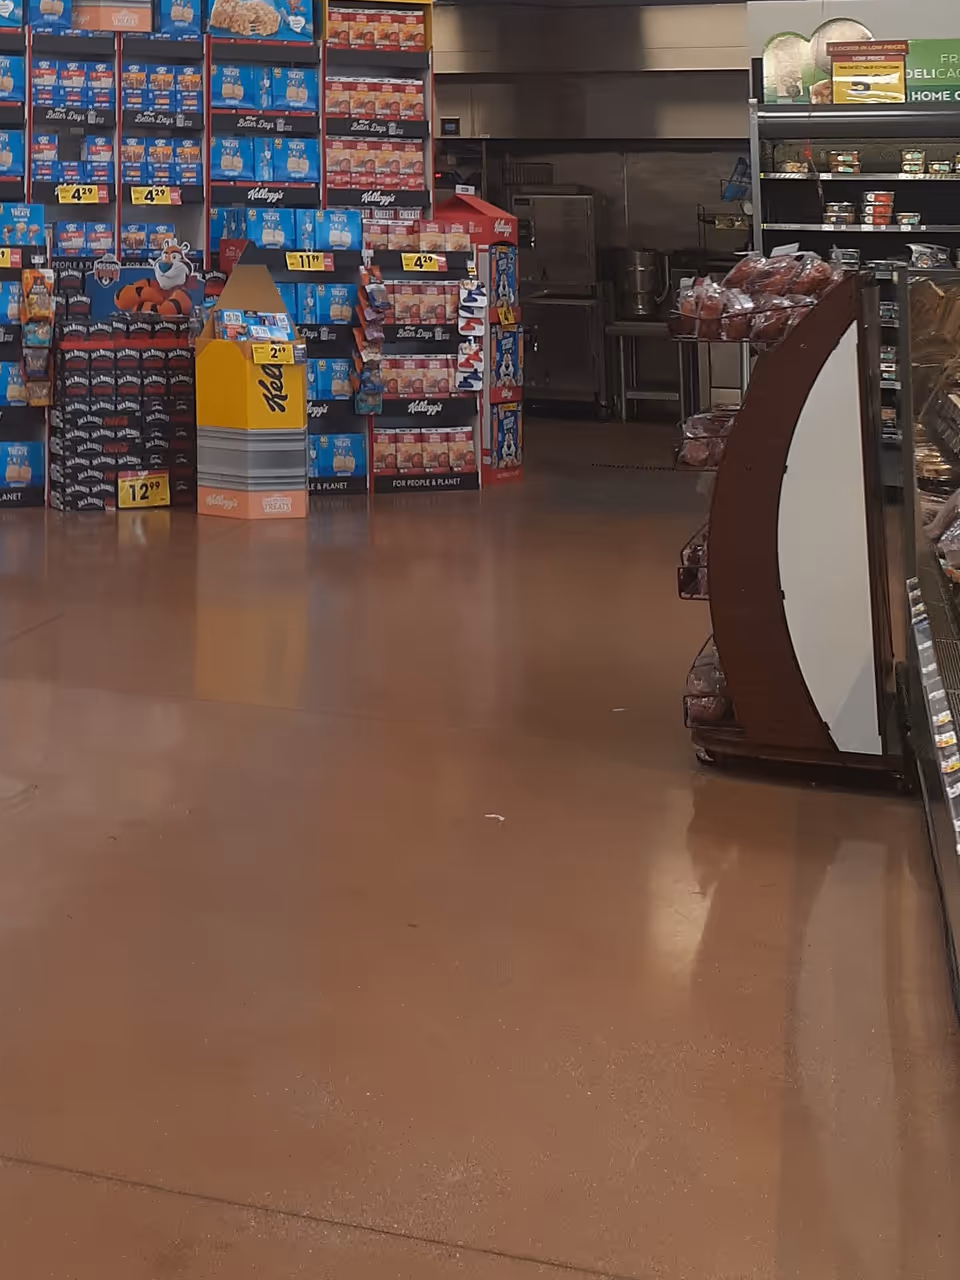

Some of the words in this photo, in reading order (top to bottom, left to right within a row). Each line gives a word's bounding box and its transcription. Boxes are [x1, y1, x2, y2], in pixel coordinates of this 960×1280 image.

[940, 54, 960, 64] FR
[911, 91, 951, 101] HOME
[248, 187, 284, 202] Kellogg's
[361, 190, 396, 205] Kellogg's
[408, 400, 442, 415] Kellogg's
[322, 482, 348, 490] PLANET
[407, 479, 431, 487] PEOPLE
[438, 477, 461, 486] PLANET
